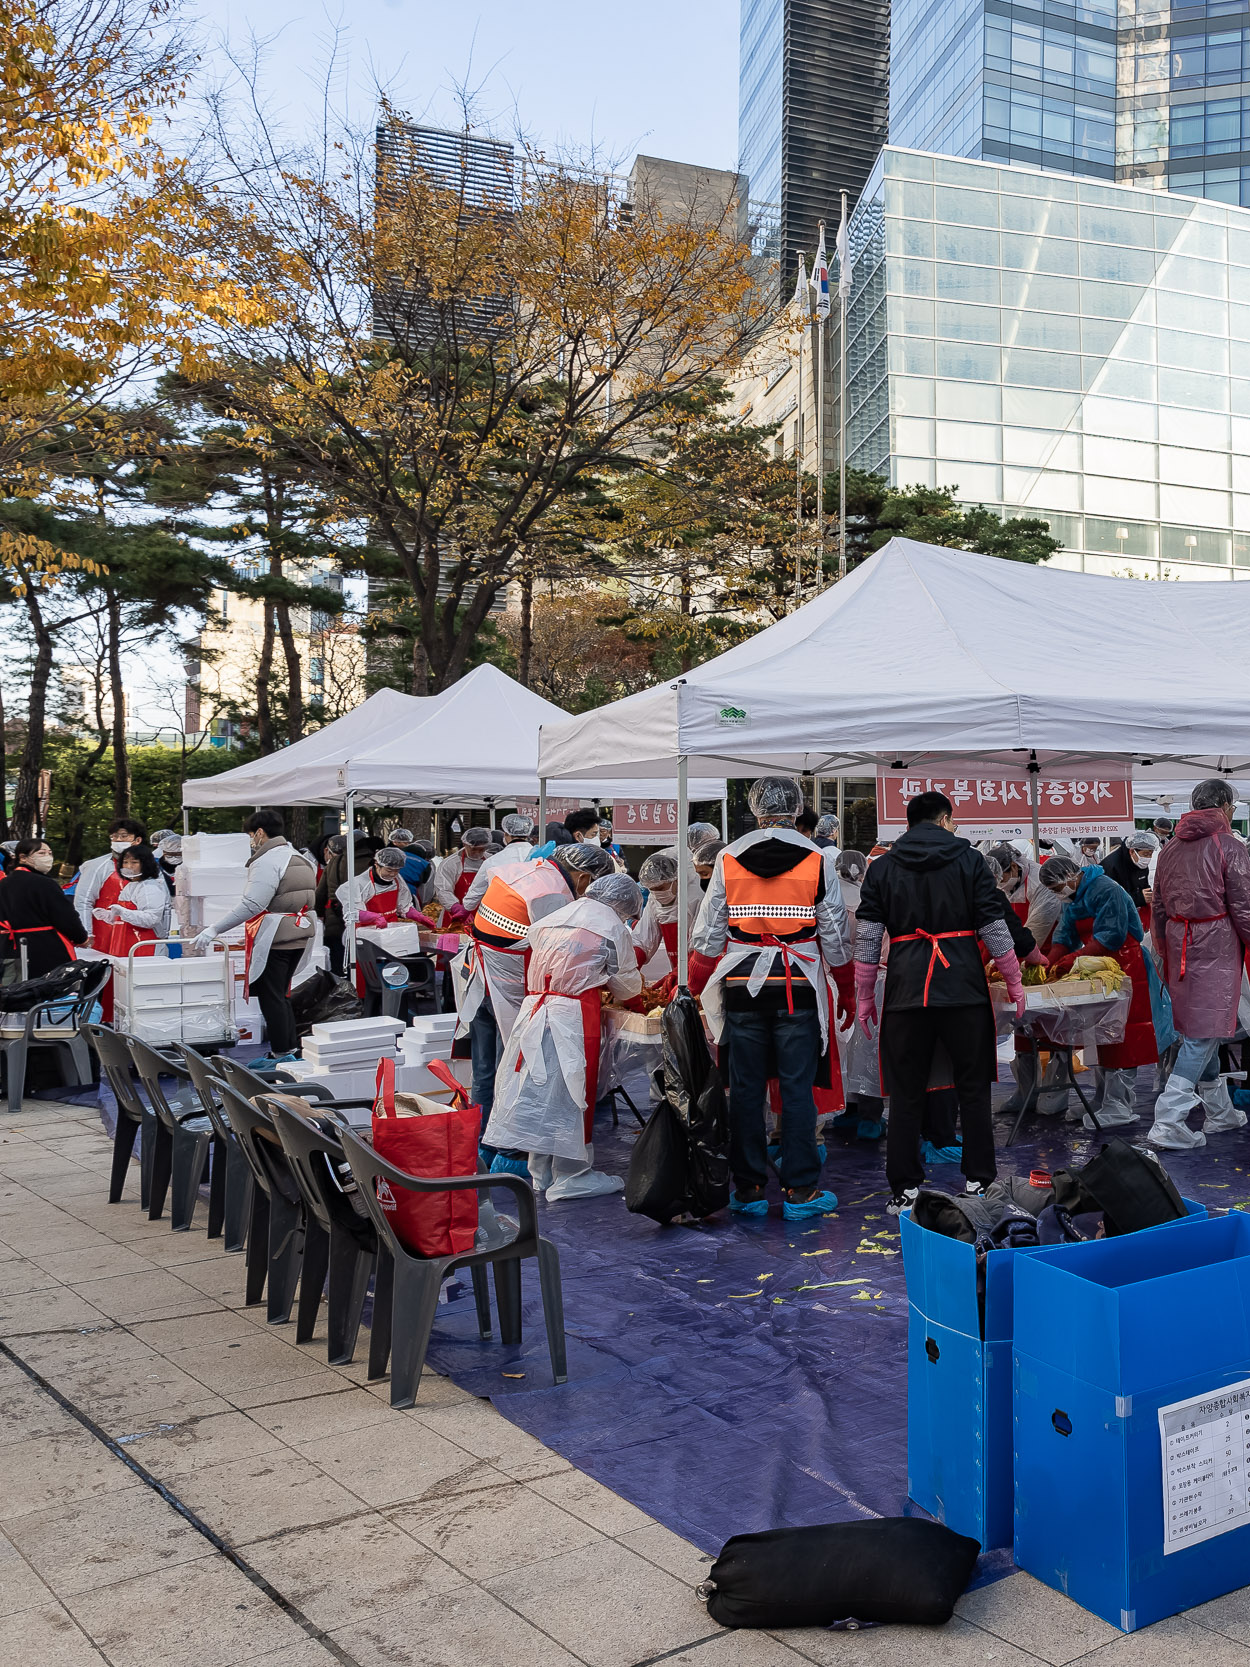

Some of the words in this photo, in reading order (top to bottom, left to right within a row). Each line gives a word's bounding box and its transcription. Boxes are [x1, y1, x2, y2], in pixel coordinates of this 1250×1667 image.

[1225, 1434, 1231, 1443] 25
[1225, 1449, 1232, 1457] 50
[1227, 1507, 1234, 1515] 39
